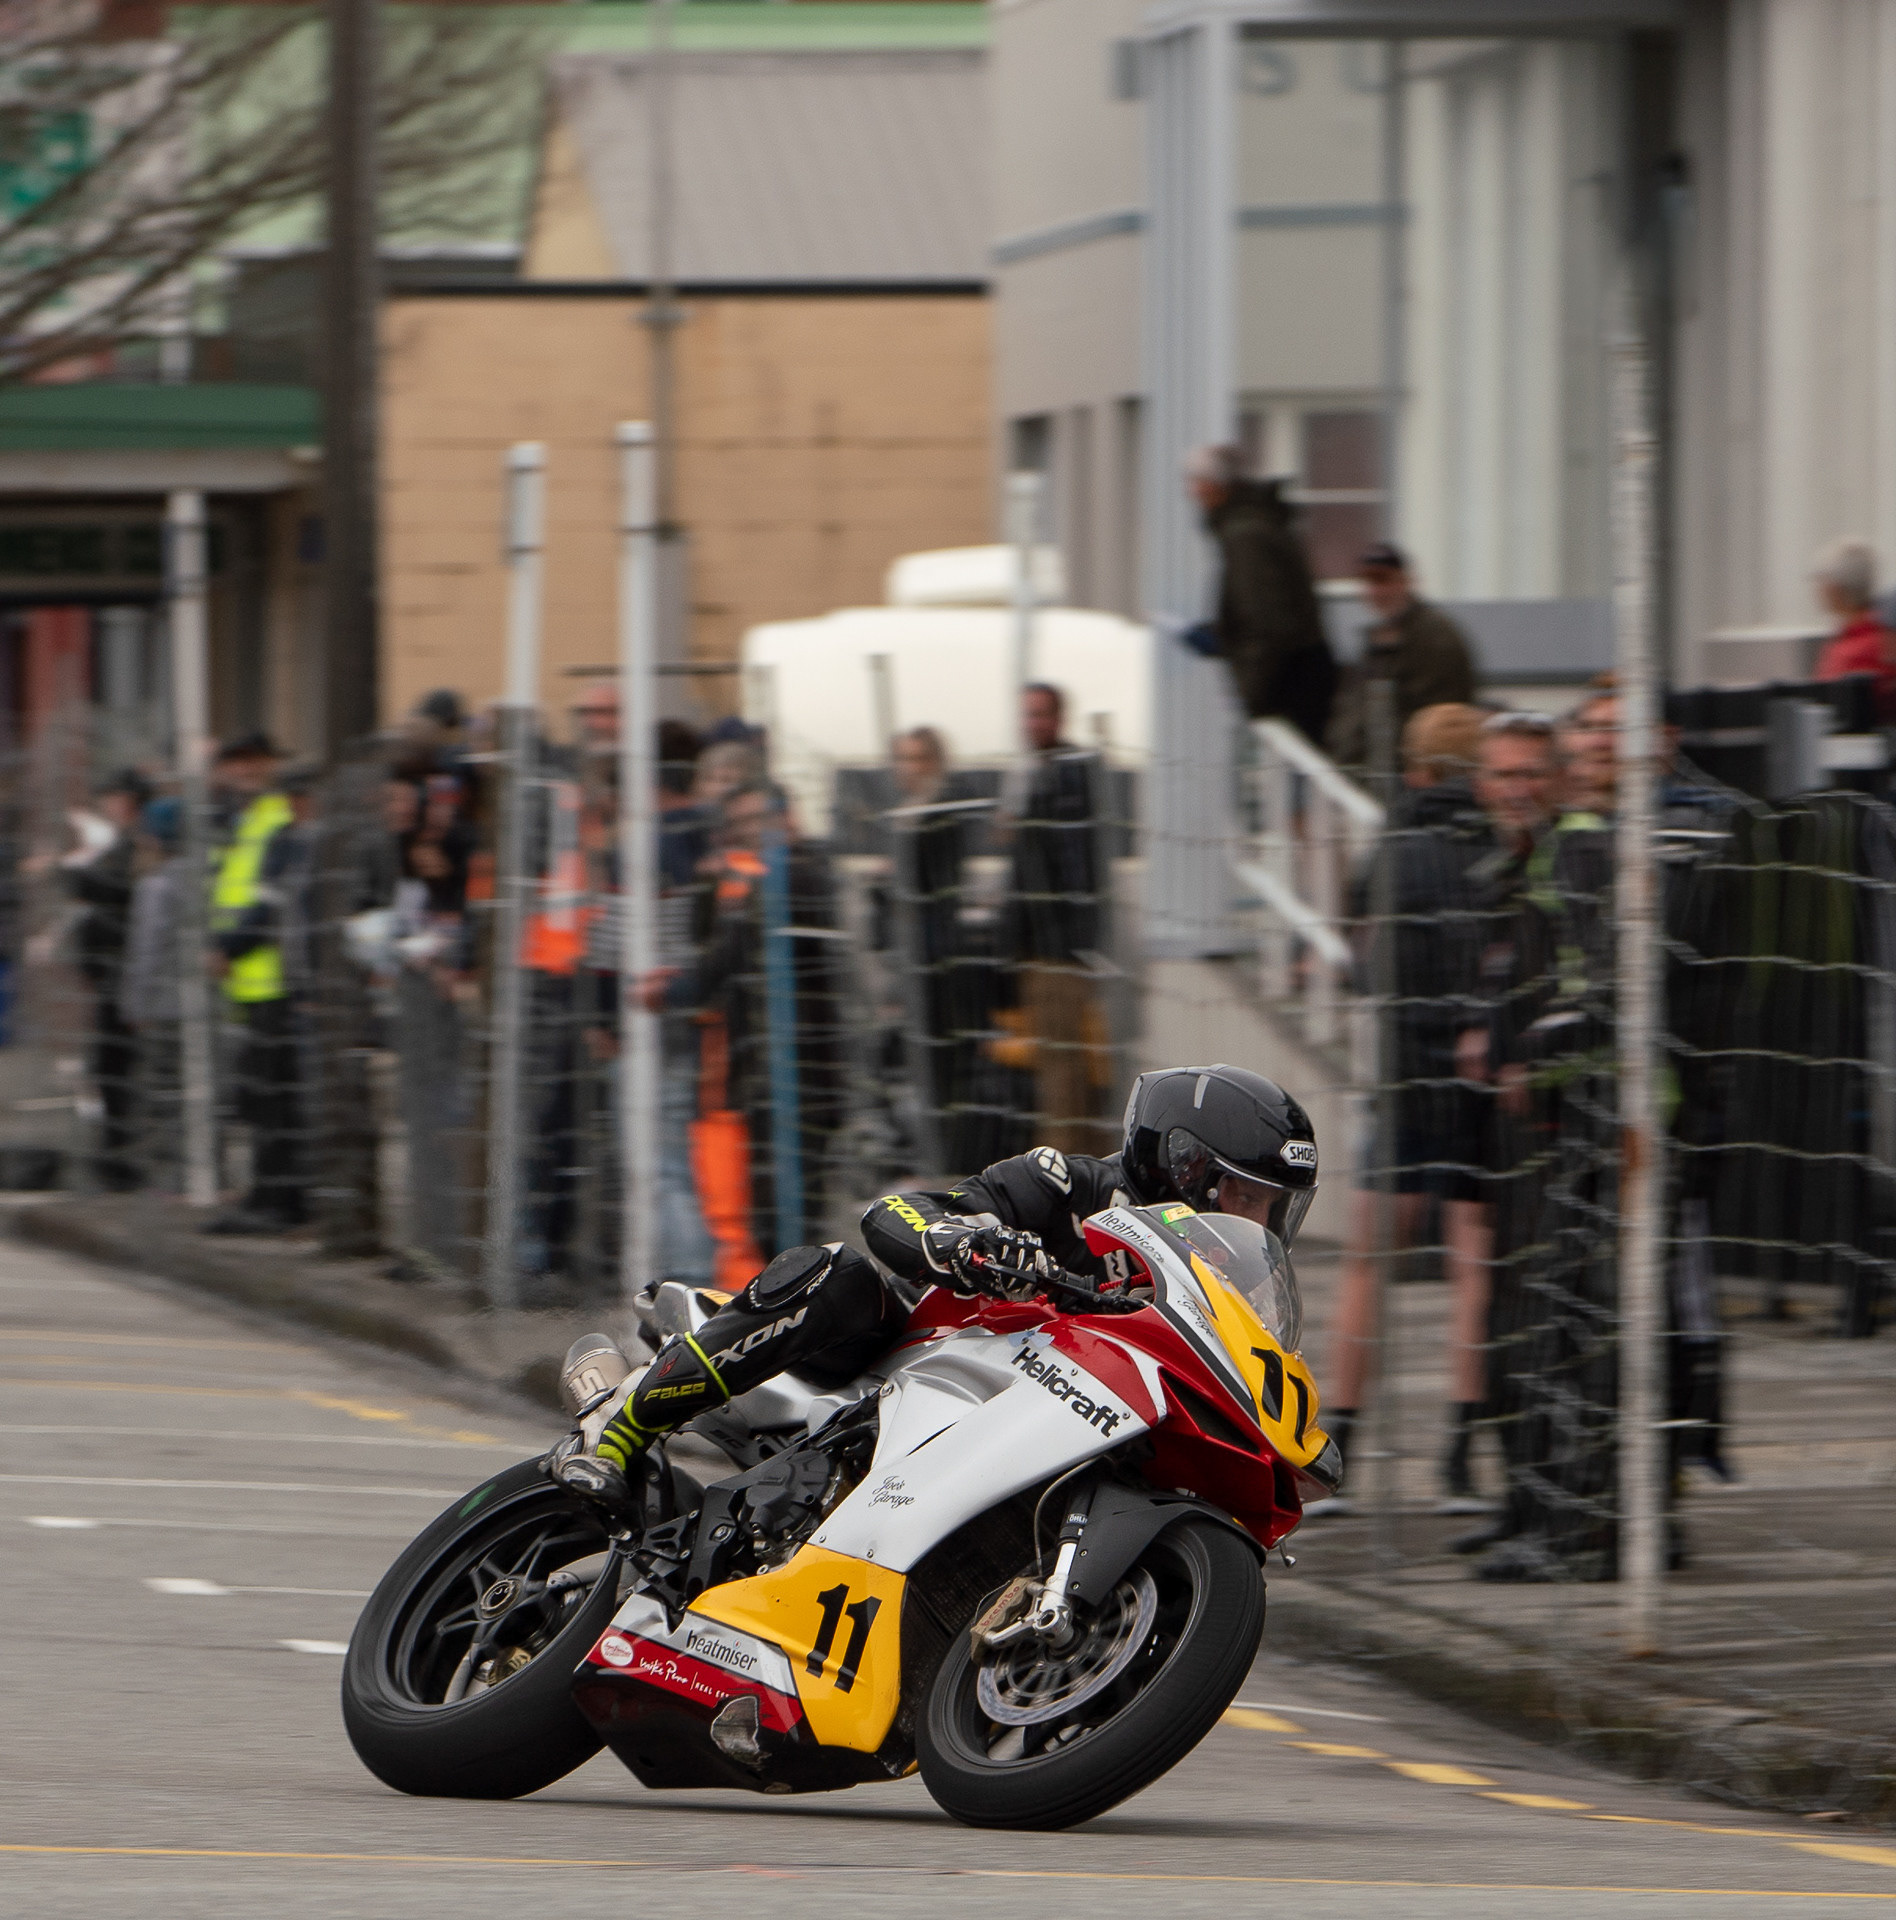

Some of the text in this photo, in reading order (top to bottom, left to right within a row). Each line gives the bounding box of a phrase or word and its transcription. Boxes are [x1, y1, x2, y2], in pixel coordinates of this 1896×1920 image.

[1290, 1146, 1315, 1162] SHOE
[709, 1306, 809, 1371] XON
[1011, 1346, 1121, 1438] Helicraft
[1250, 1346, 1306, 1453] 11
[806, 1583, 883, 1694] 11
[981, 1586, 1020, 1627] brembo
[686, 1629, 758, 1671] heatmiser
